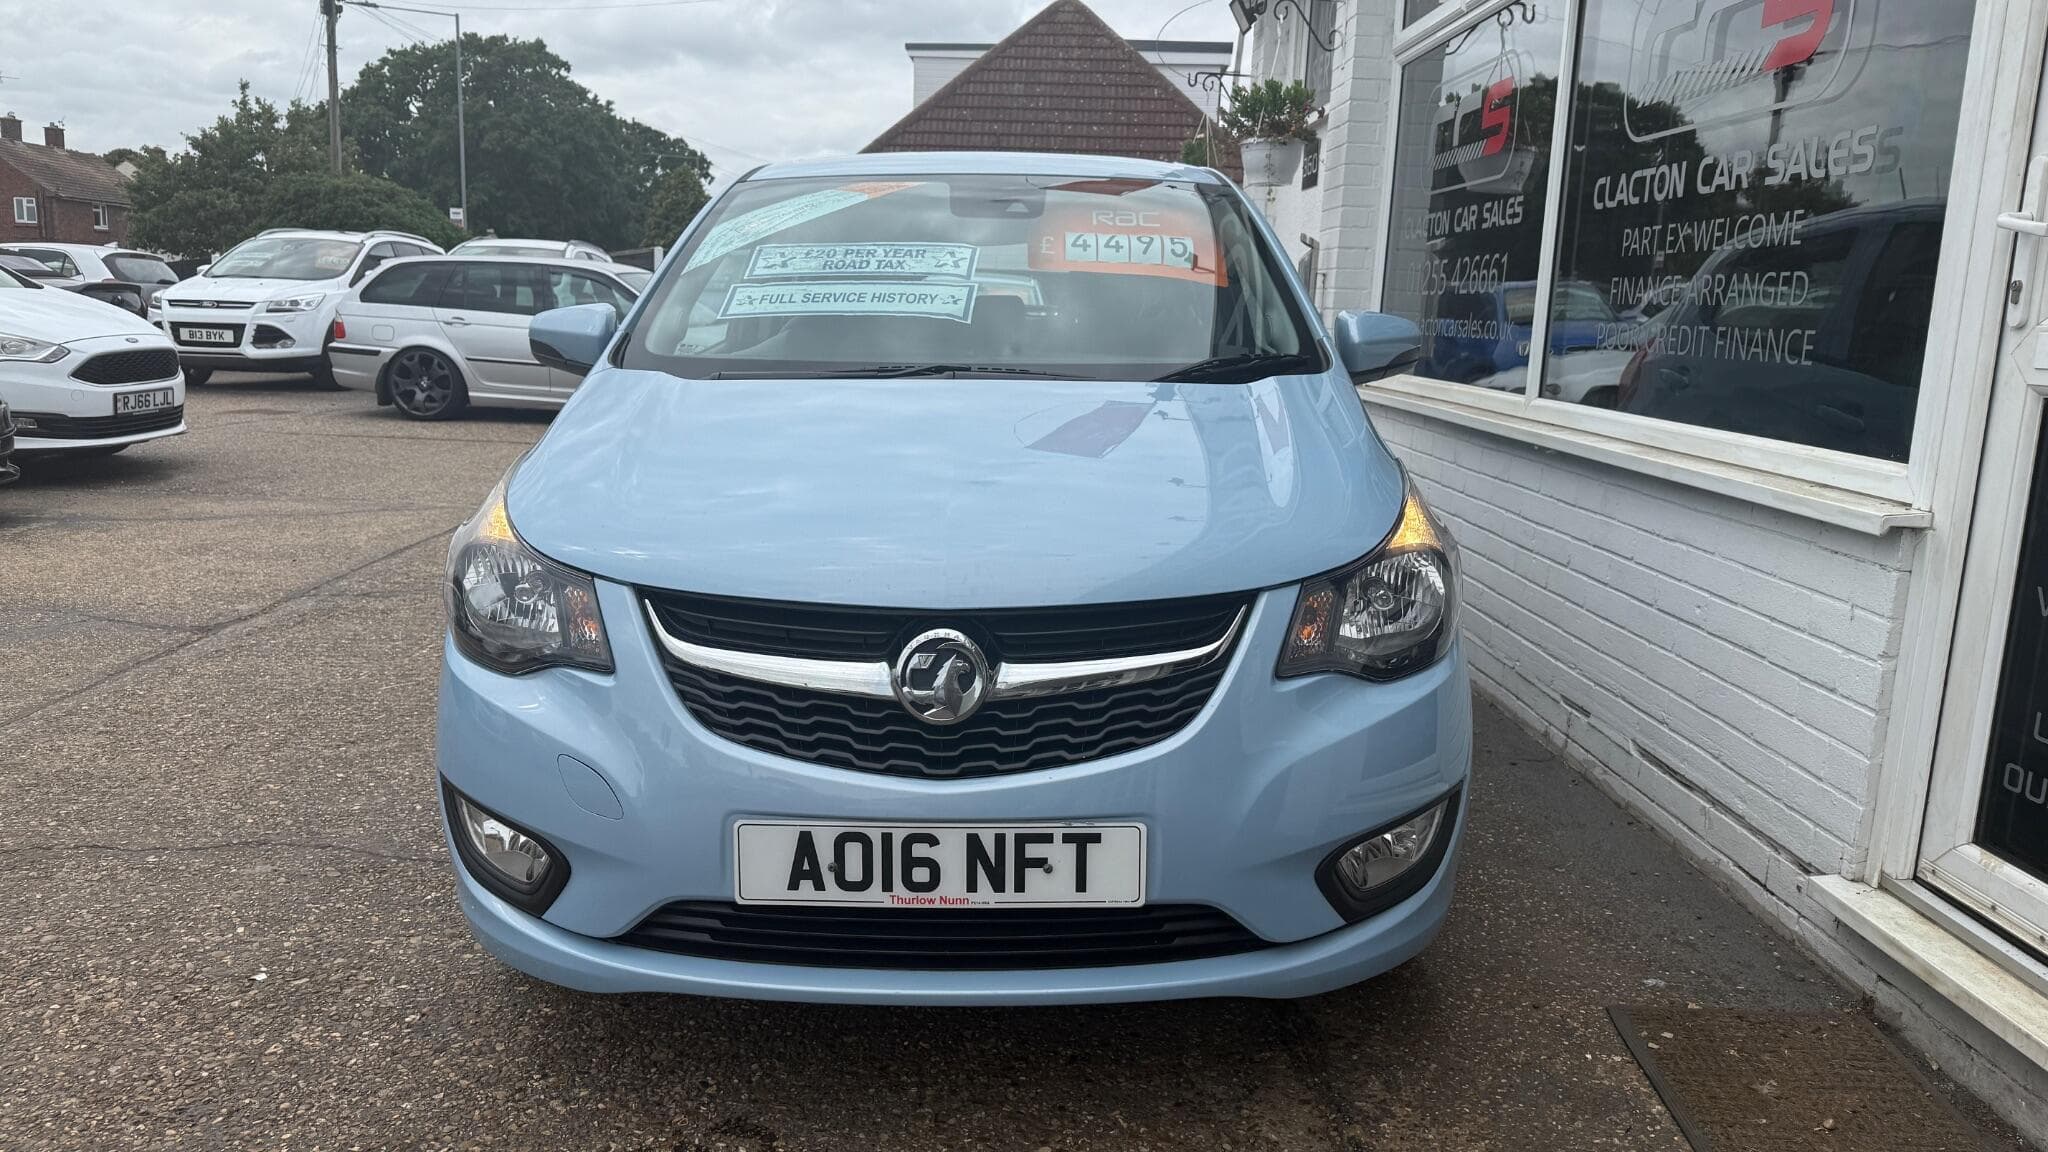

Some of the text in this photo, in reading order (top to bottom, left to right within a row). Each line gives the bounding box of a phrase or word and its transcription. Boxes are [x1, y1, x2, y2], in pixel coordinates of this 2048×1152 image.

[1594, 125, 1877, 209] CLACTON CAR SALES
[1405, 195, 1524, 240] CLACTON CAR SALES
[1622, 209, 1805, 257] PART EX WELCOME
[803, 248, 927, 259] £20 PER YEAR
[822, 259, 906, 270] ROAD TAX
[1040, 233, 1188, 258] £ 4495
[1407, 252, 1509, 296] 01255 426661
[1609, 270, 1809, 308] FINANCE ARRANGED
[758, 292, 939, 305] FULL SERVICE HISTORY
[205, 330, 225, 341] BYK
[1595, 322, 1816, 366] POOR CREDIT FINANCE
[122, 391, 172, 411] RJ66 LJL
[2003, 762, 2048, 809] OU
[786, 829, 1102, 894] AO16 NFT
[889, 895, 970, 905] Thurlow Nunn
